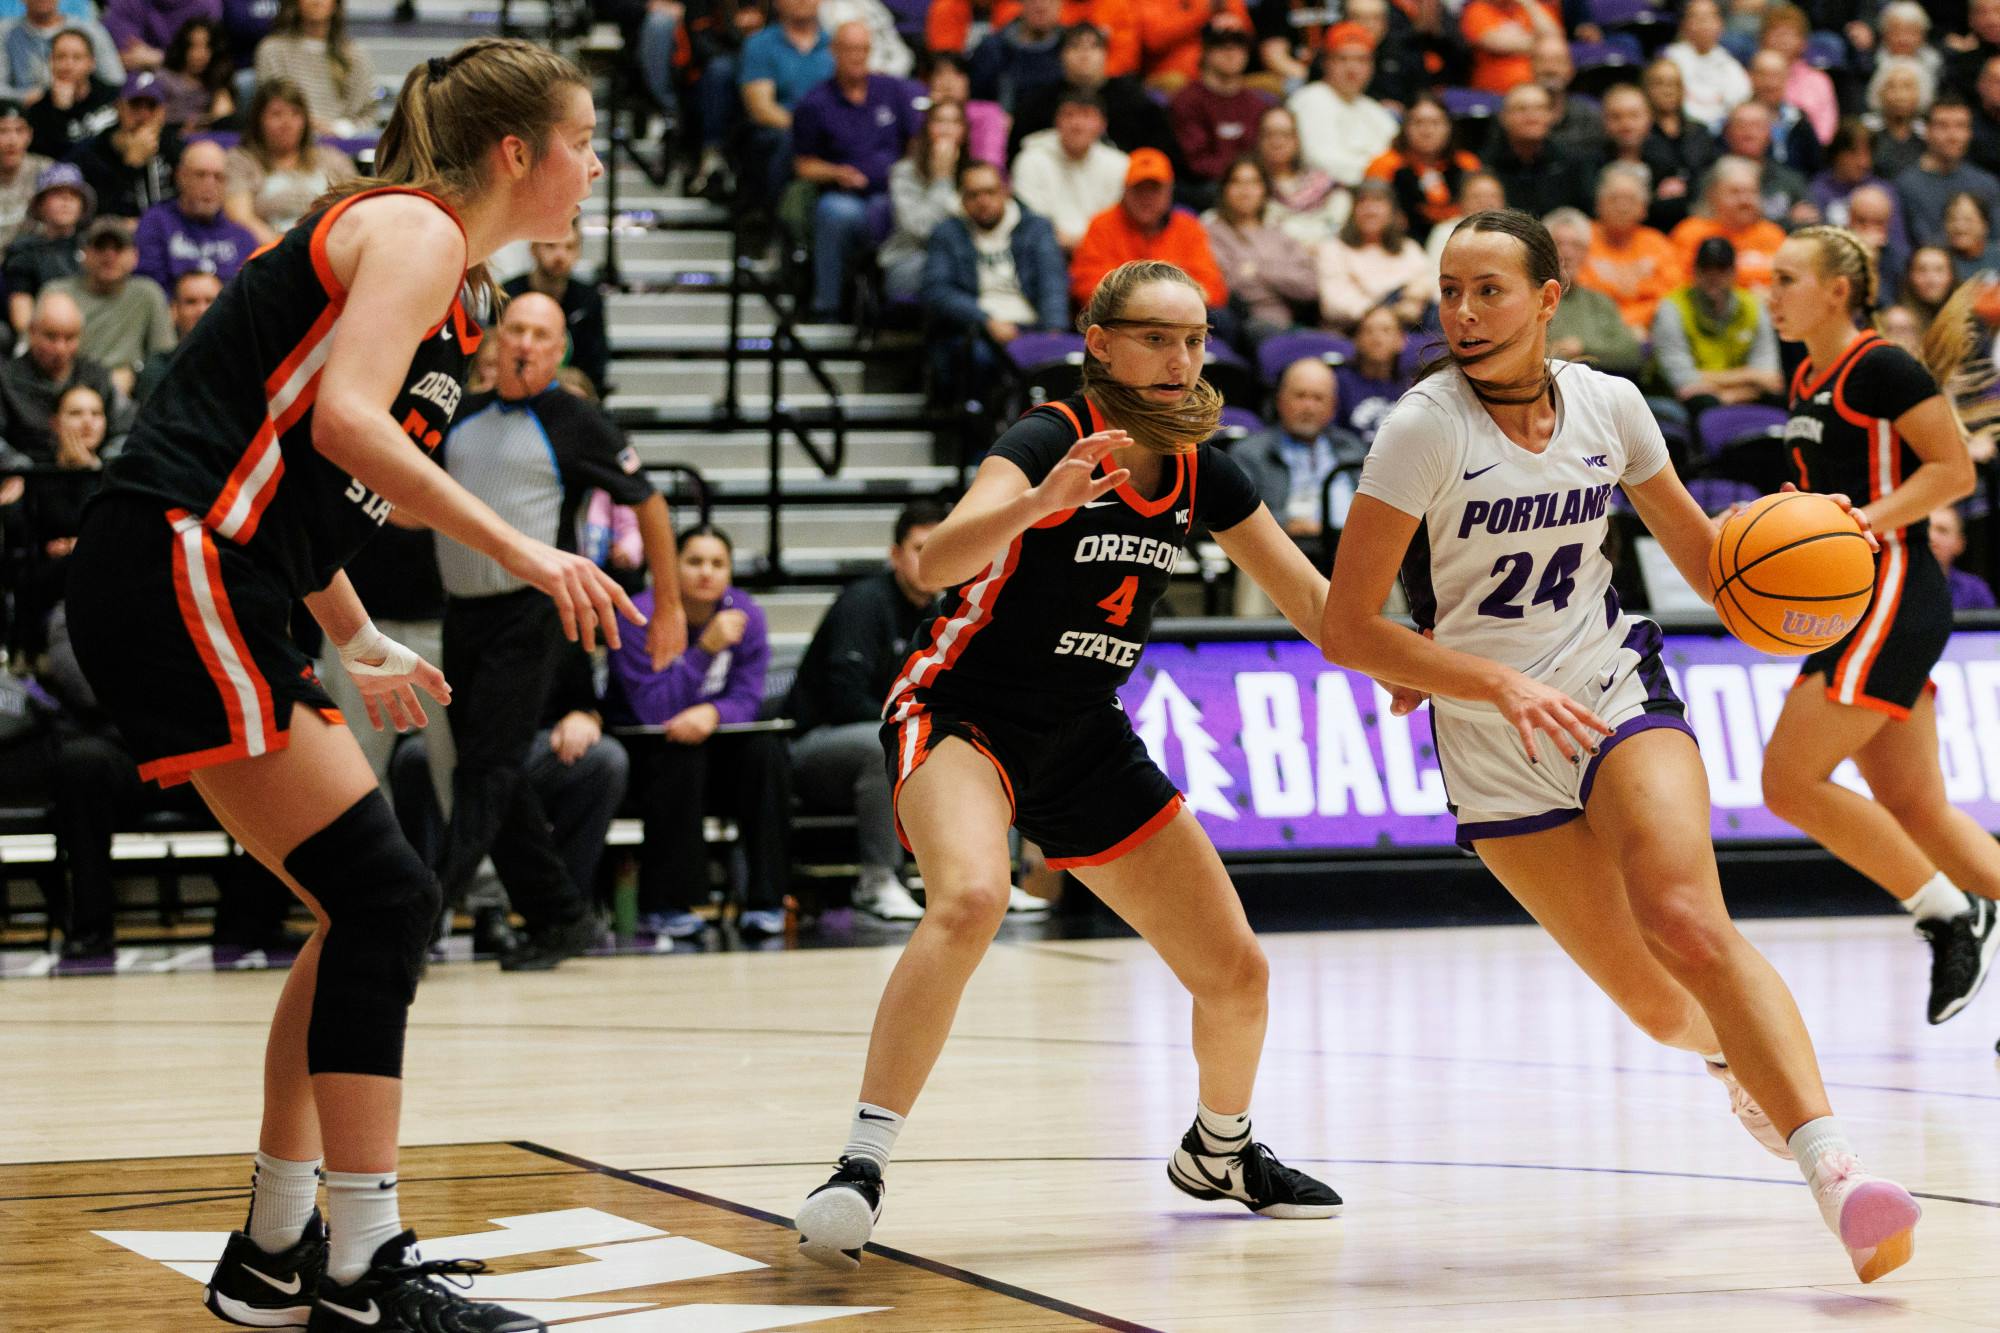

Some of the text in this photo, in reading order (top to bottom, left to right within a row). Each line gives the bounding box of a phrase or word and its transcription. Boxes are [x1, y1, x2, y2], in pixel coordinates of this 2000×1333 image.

[1457, 483, 1612, 539] PORTLAND
[1074, 534, 1182, 575] OREGON
[1096, 575, 1139, 626] 4
[1478, 543, 1583, 618] 24
[1054, 630, 1142, 668] STATE
